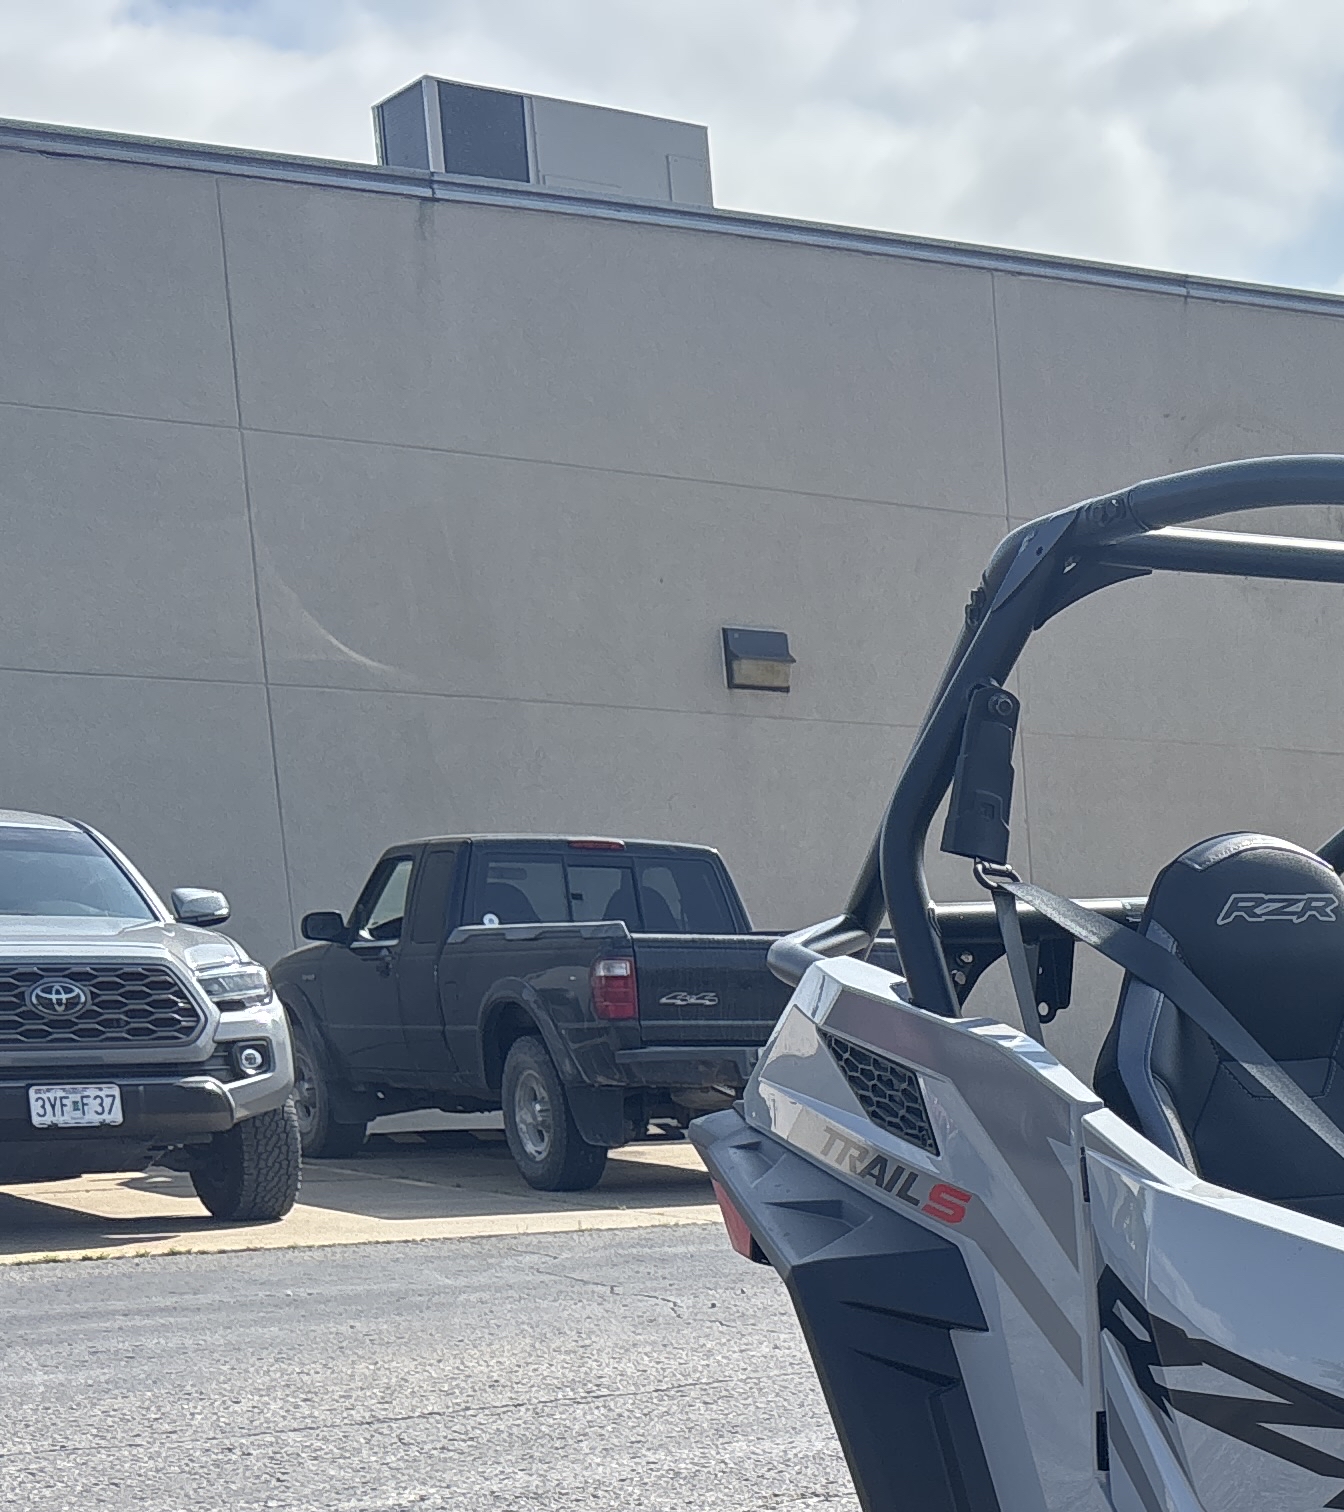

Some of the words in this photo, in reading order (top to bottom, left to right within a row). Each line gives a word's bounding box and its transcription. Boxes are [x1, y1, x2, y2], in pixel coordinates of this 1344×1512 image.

[1216, 893, 1338, 925] RZR
[819, 1125, 921, 1207] TRAIL
[921, 1183, 973, 1224] S
